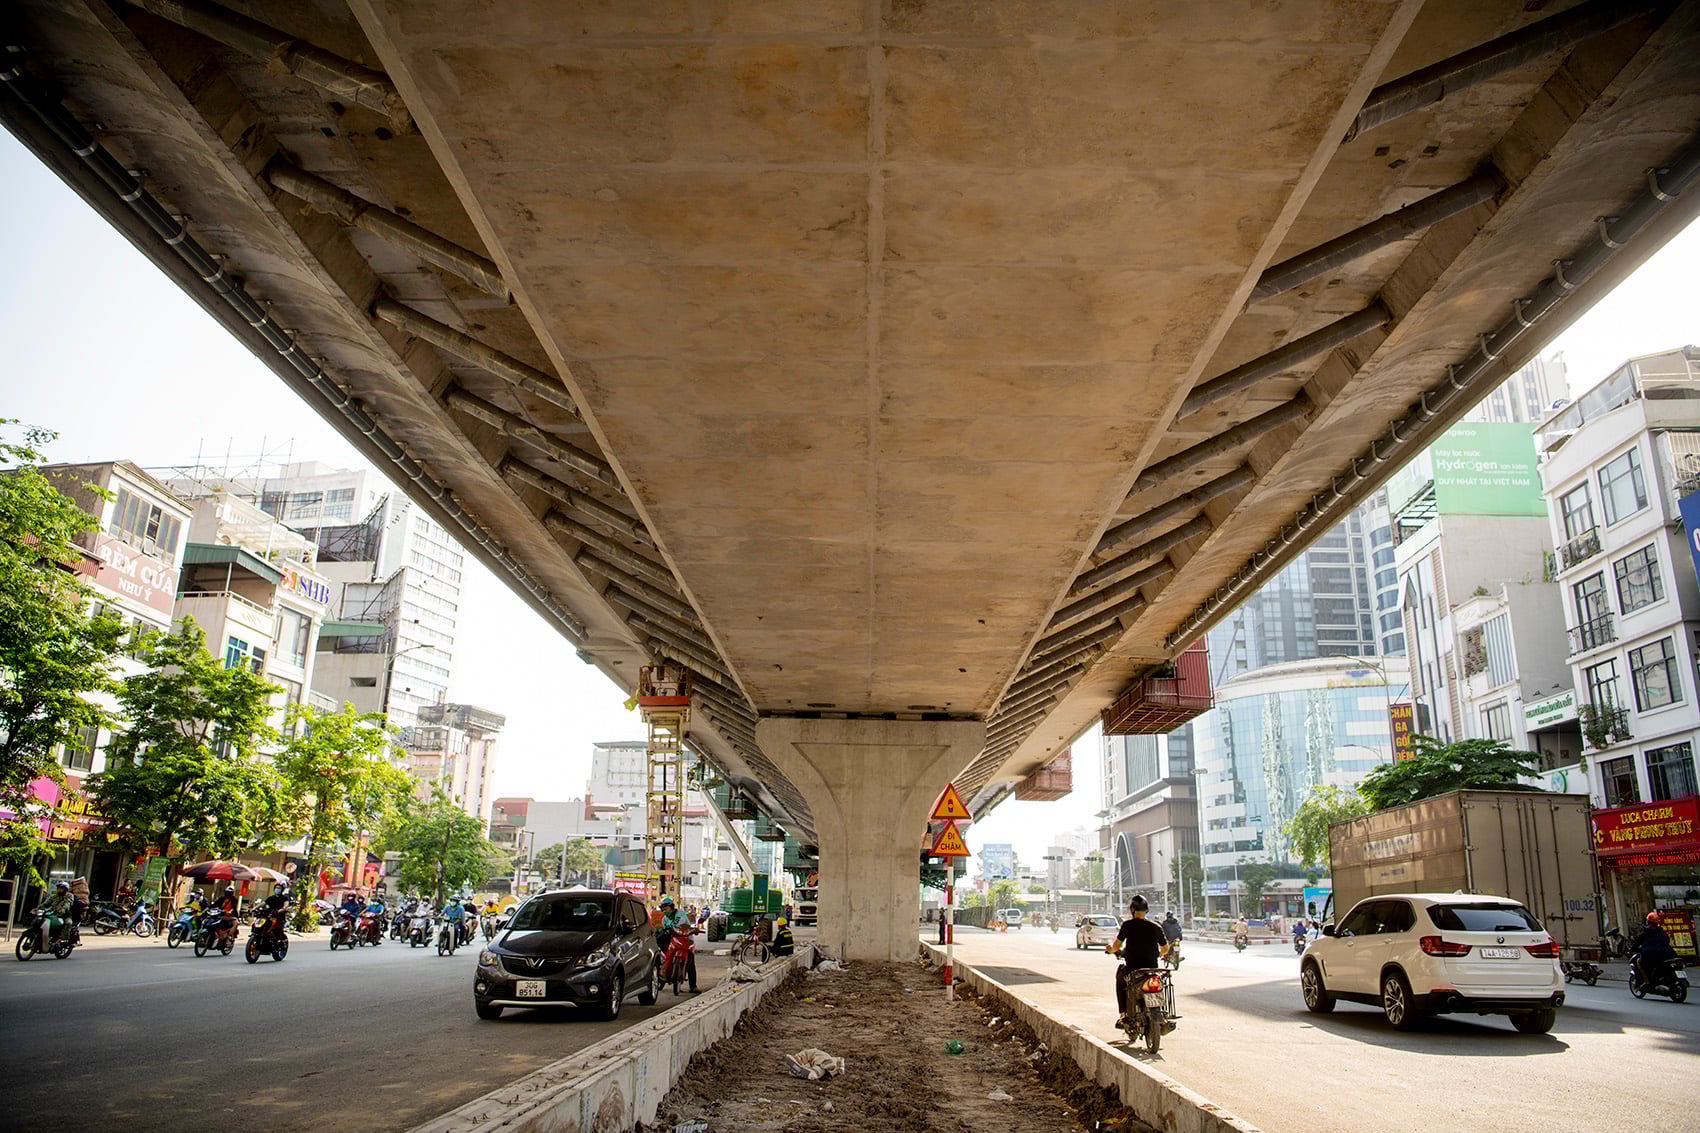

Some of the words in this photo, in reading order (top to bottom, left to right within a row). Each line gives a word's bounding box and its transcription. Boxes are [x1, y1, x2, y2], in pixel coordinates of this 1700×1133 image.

[300, 575, 329, 604] SHB
[1620, 812, 1641, 824] LUCA
[1642, 807, 1673, 821] CHARM
[1565, 899, 1594, 911] 100.32
